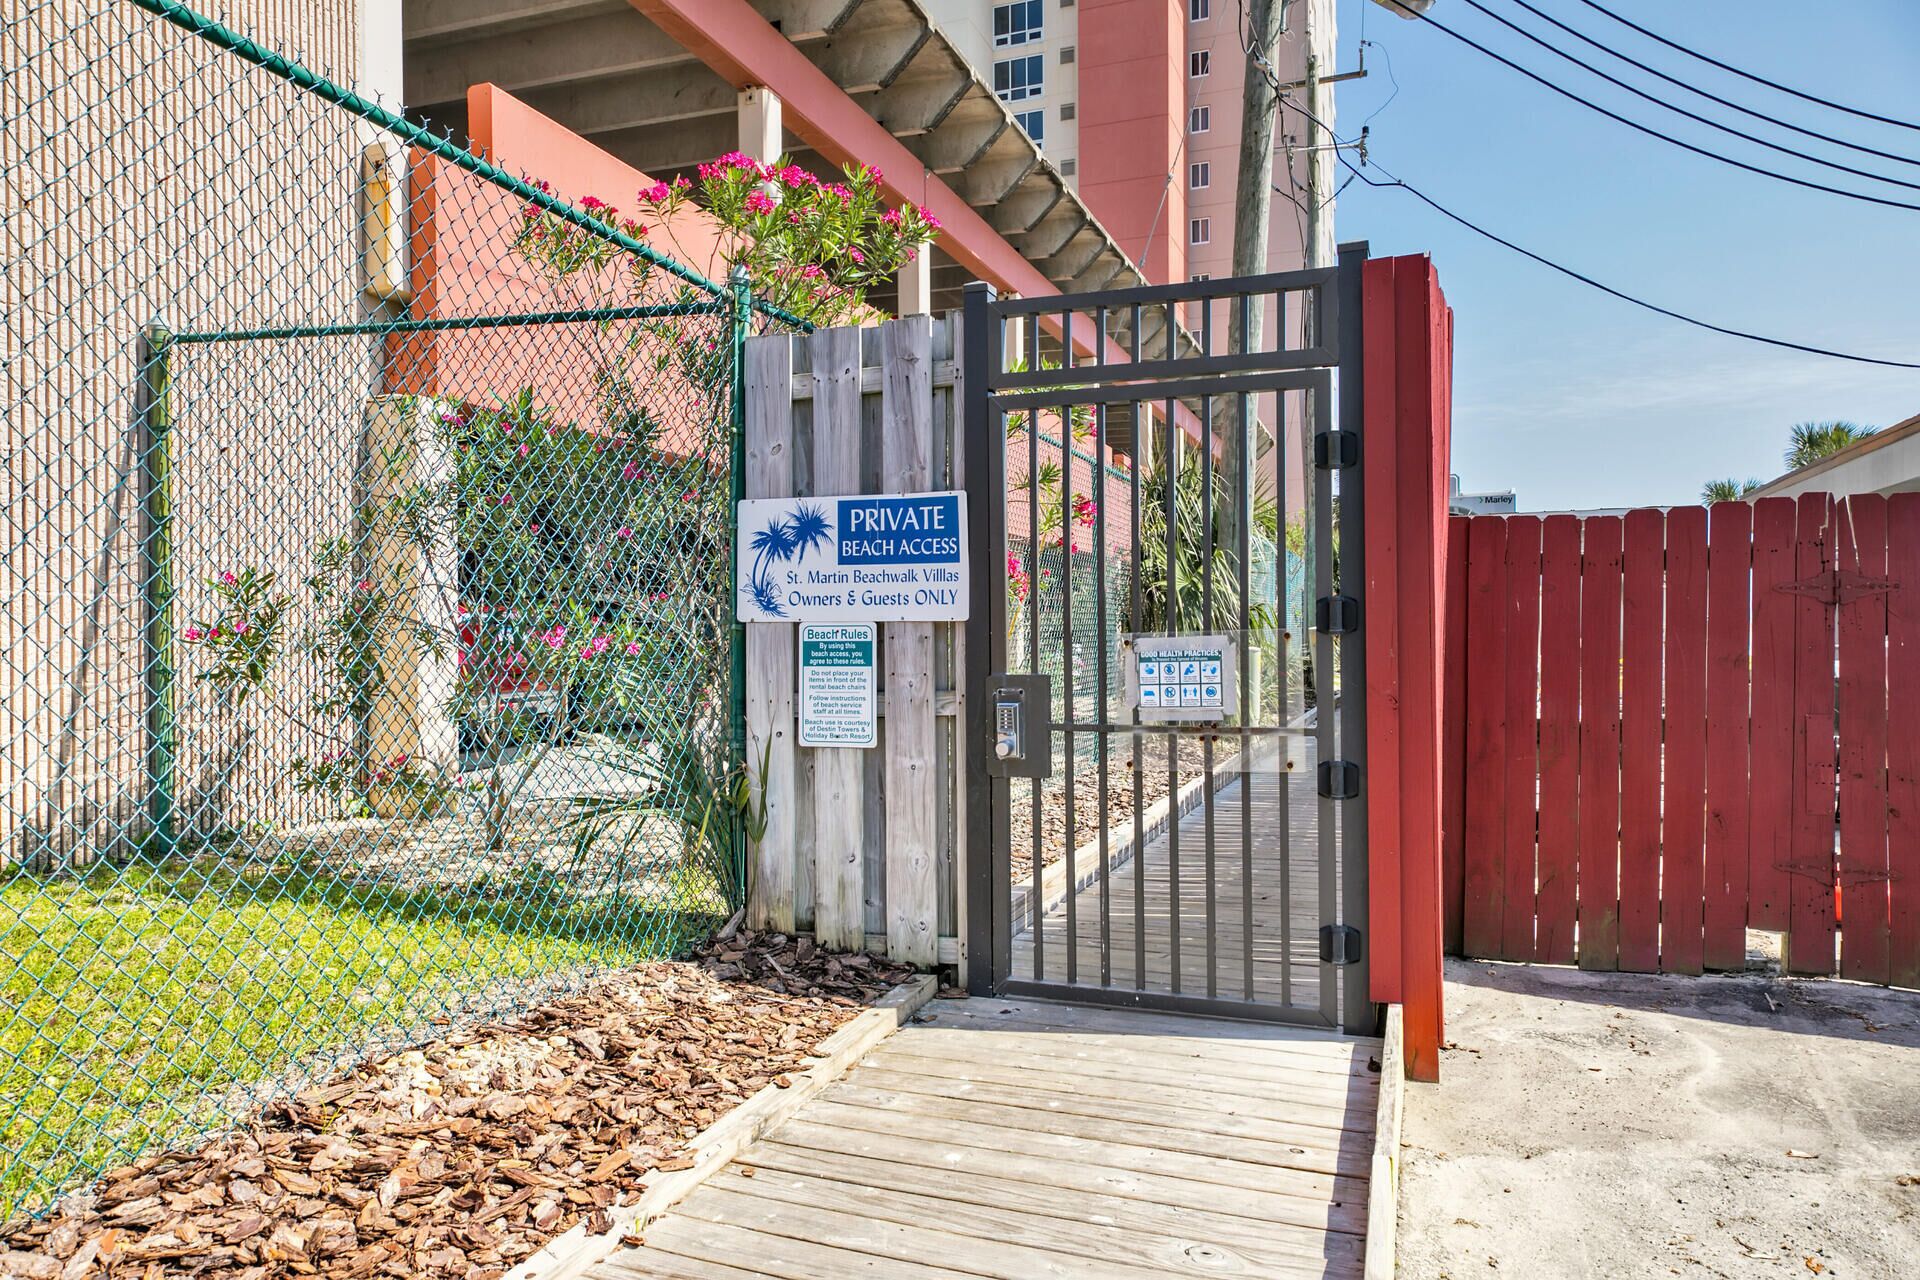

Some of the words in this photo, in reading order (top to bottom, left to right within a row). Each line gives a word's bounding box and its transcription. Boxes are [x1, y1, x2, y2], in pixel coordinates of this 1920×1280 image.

[1485, 496, 1513, 504] Marley
[850, 506, 945, 532] PRIVATE
[842, 539, 894, 557] BEACH
[898, 537, 957, 556] ACCESS
[786, 571, 803, 585] St.
[807, 570, 849, 584] Martin
[853, 569, 918, 583] Beachwalk
[788, 590, 842, 607] Owners
[847, 590, 856, 606] &
[861, 589, 910, 606] Guests
[914, 589, 958, 605] ONLY
[807, 629, 838, 639] Beach
[841, 629, 868, 639] Rules
